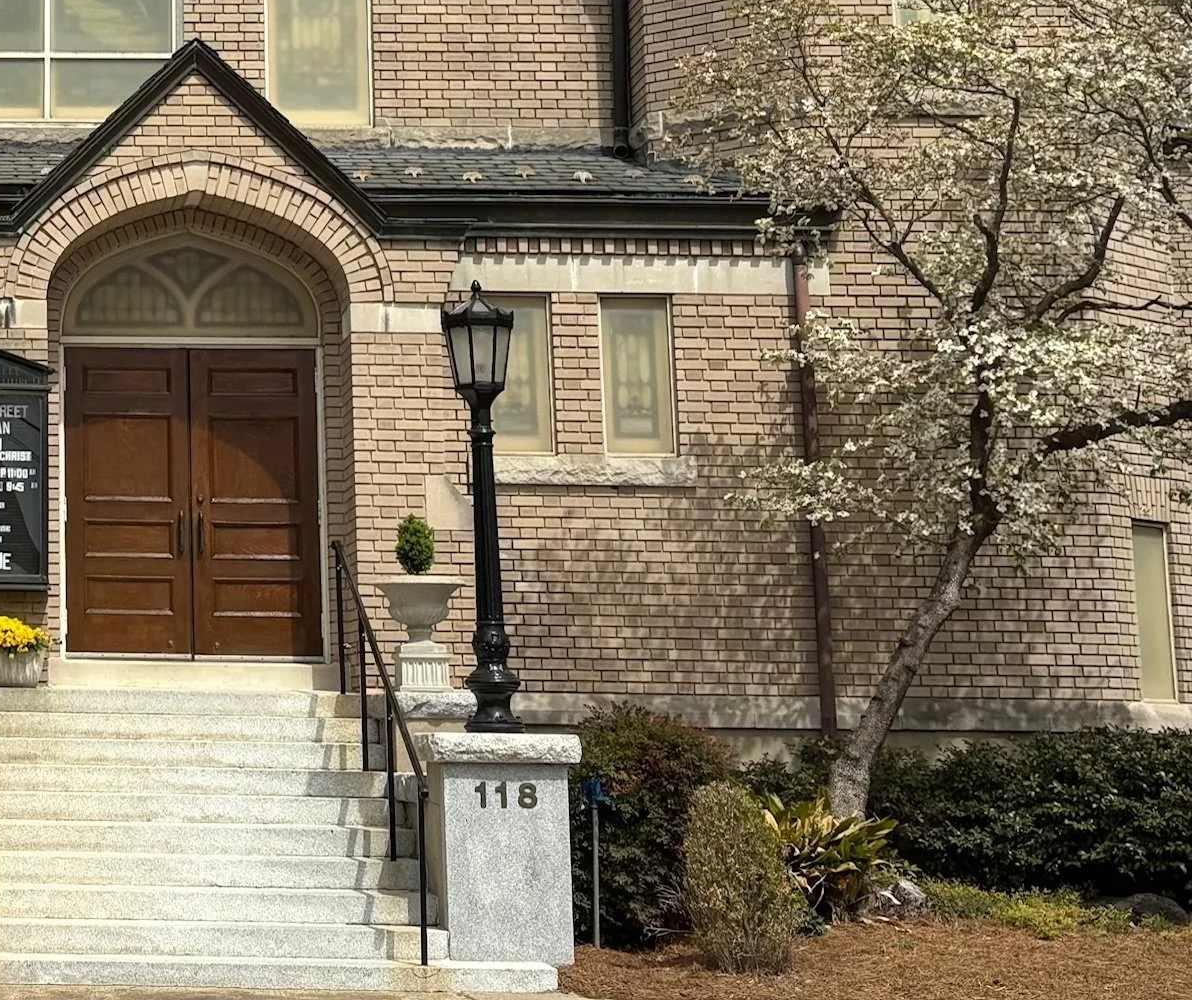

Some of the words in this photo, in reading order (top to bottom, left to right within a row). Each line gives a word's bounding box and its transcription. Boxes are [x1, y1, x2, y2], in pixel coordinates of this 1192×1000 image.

[0, 451, 32, 461] CHRIST
[8, 468, 28, 479] 11:00
[475, 781, 538, 809] 118
